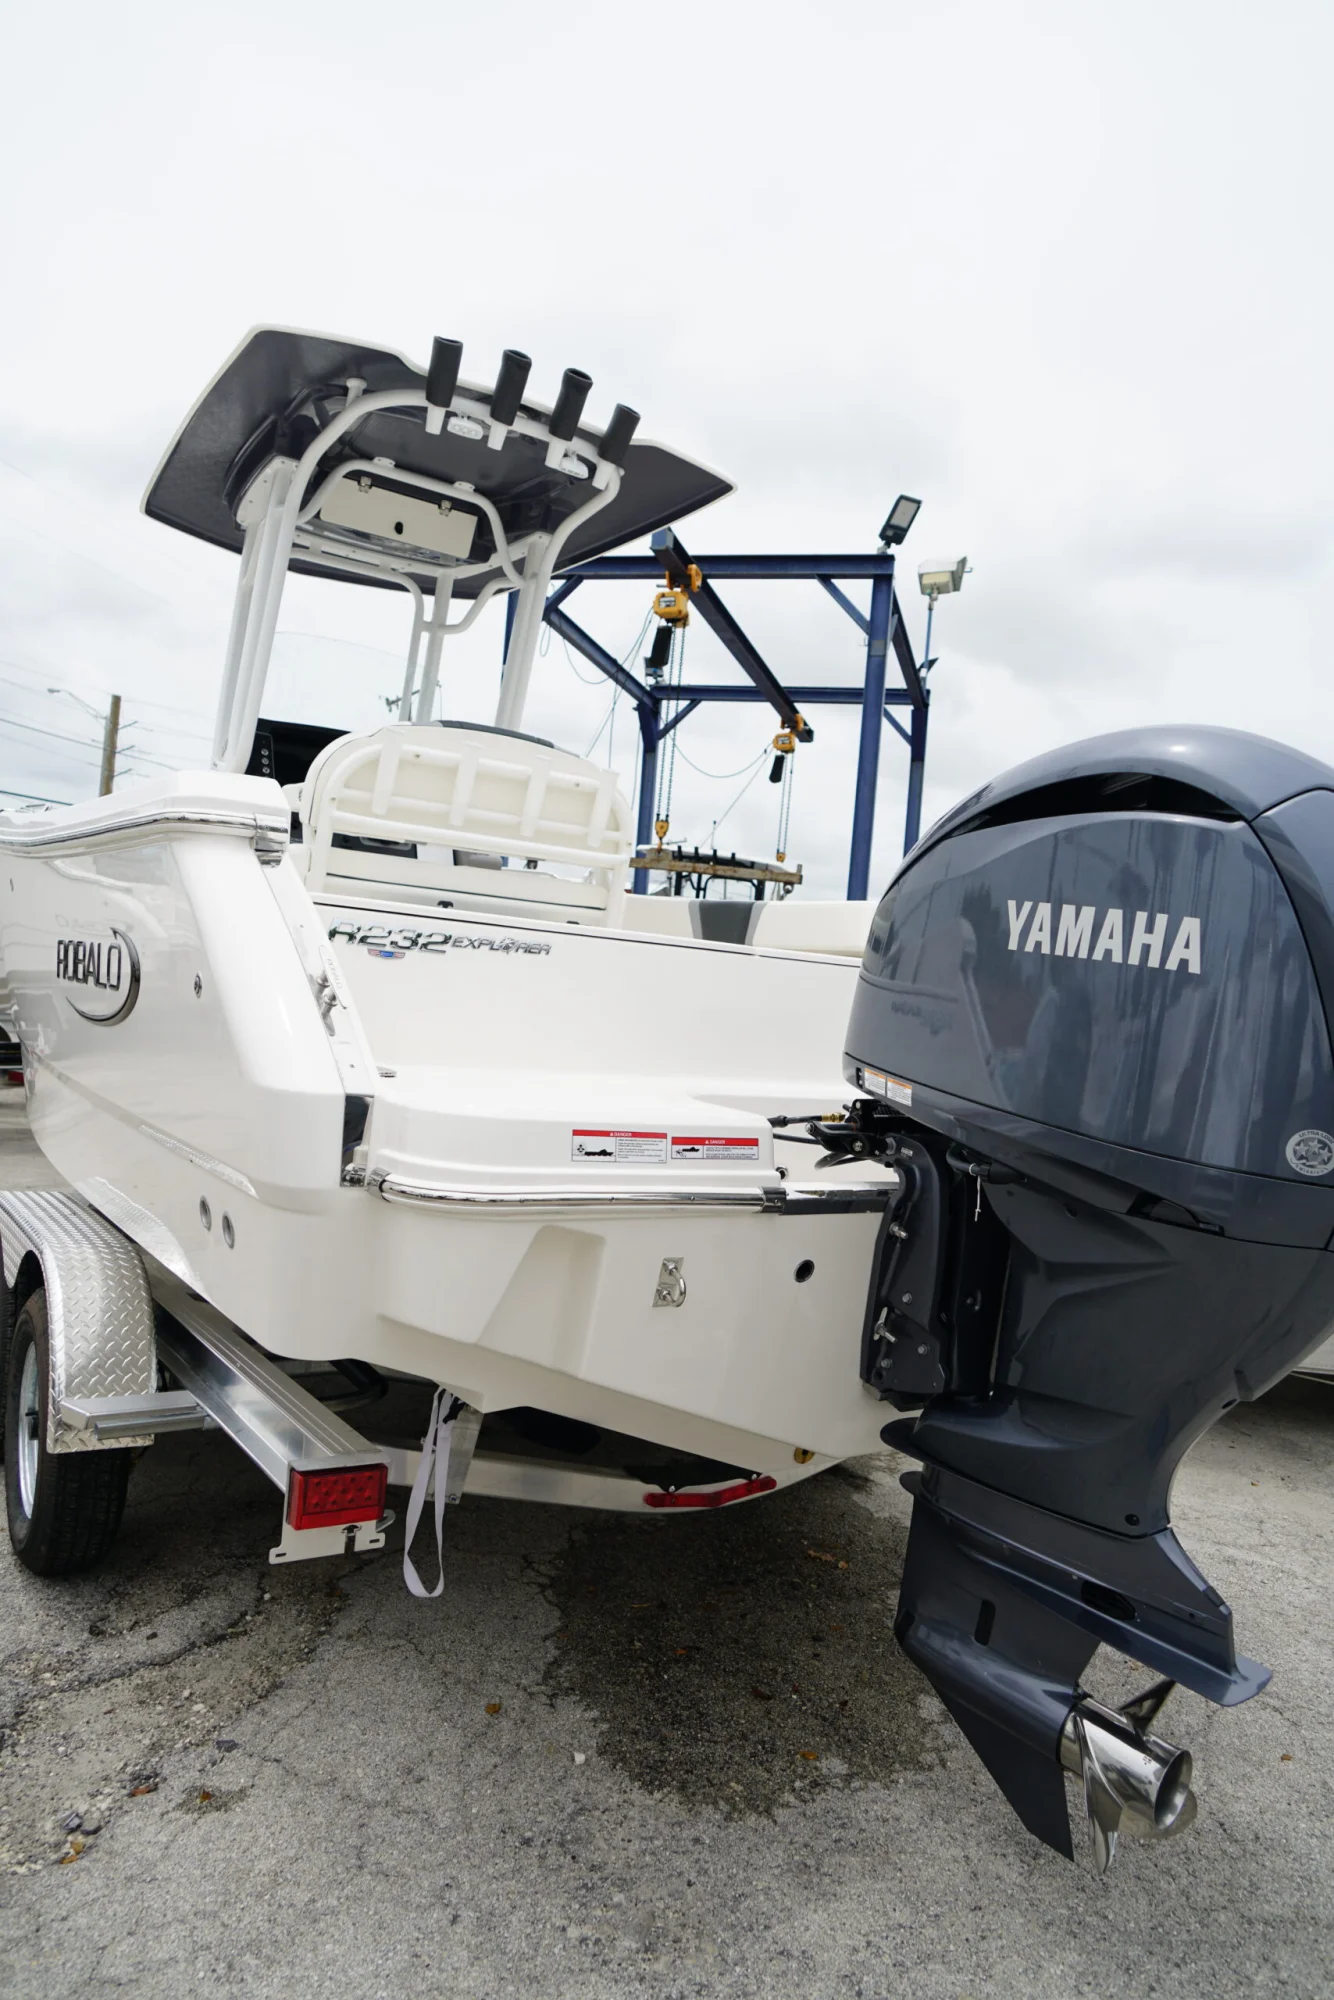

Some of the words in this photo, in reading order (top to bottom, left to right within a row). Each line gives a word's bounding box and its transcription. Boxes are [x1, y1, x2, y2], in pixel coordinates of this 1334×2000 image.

[328, 917, 451, 953] R232
[452, 935, 552, 956] EXPLORER
[1007, 899, 1201, 975] YAMAHA
[56, 939, 122, 992] ROBALO
